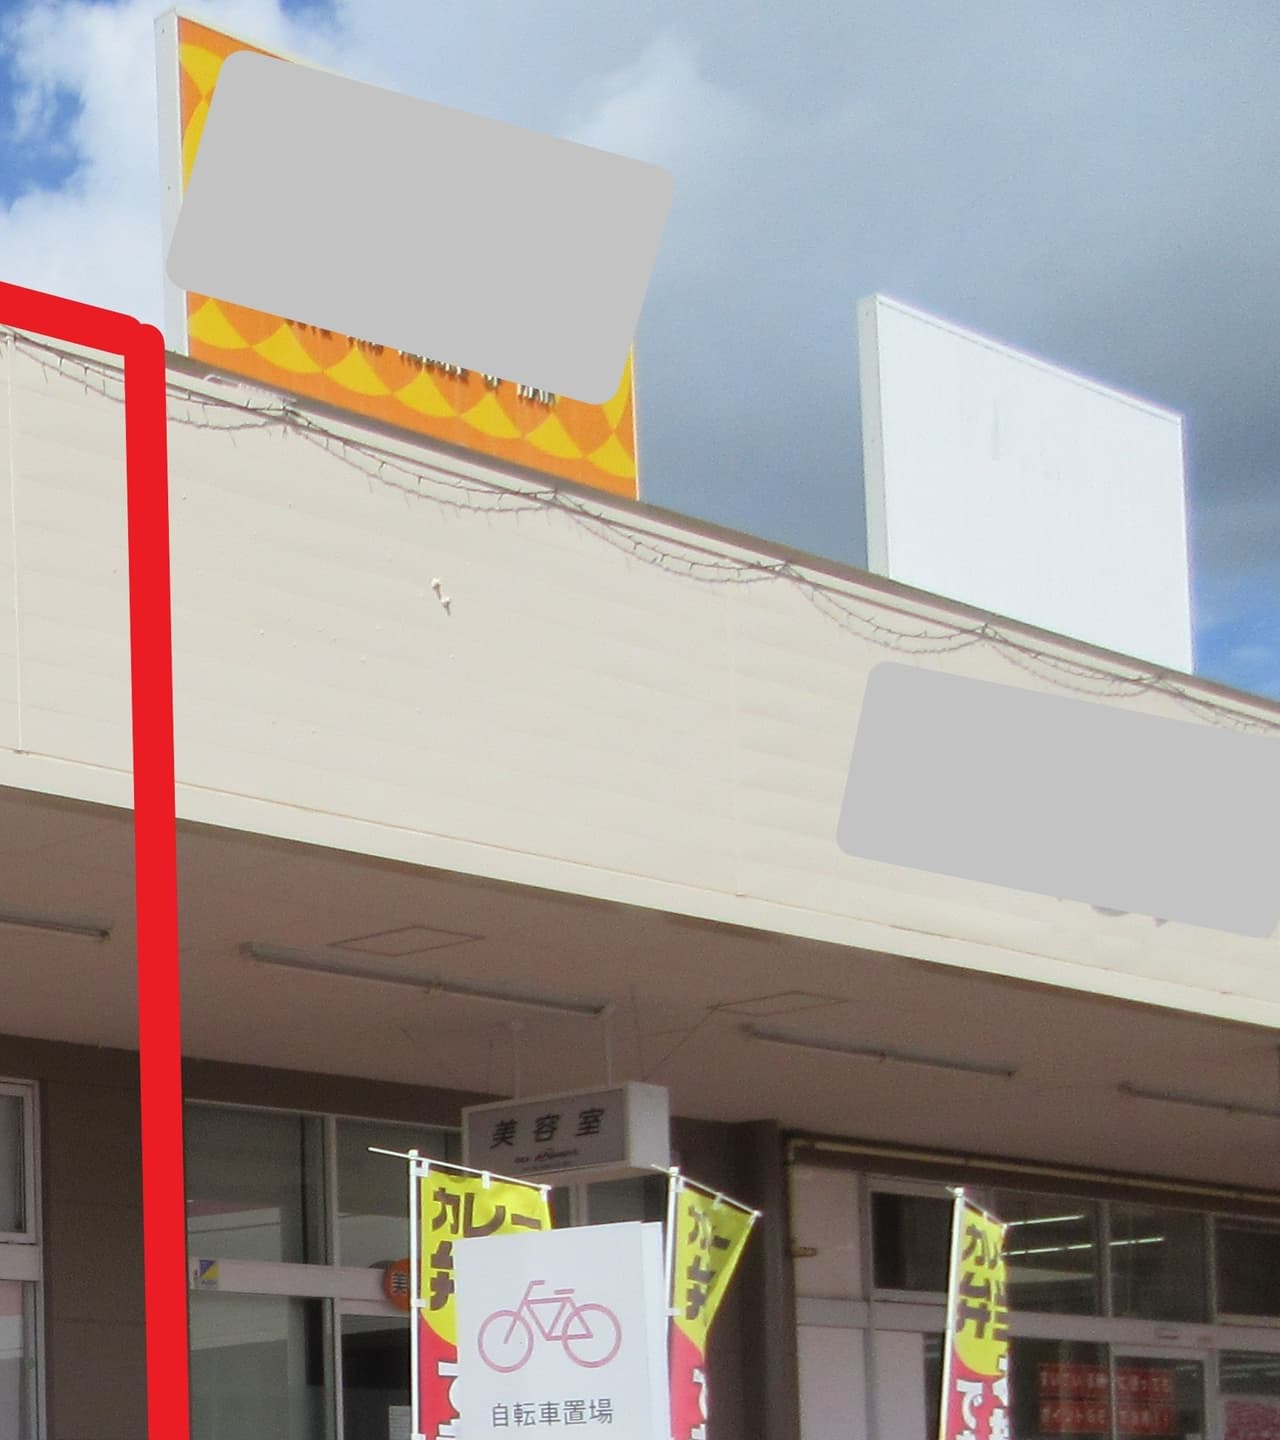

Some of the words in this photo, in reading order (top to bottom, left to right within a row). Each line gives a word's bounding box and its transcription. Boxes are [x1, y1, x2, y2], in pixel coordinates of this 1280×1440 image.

[490, 1107, 605, 1149] 美容室
[432, 1187, 542, 1239] カレー
[492, 1398, 614, 1428] 自転車置場
